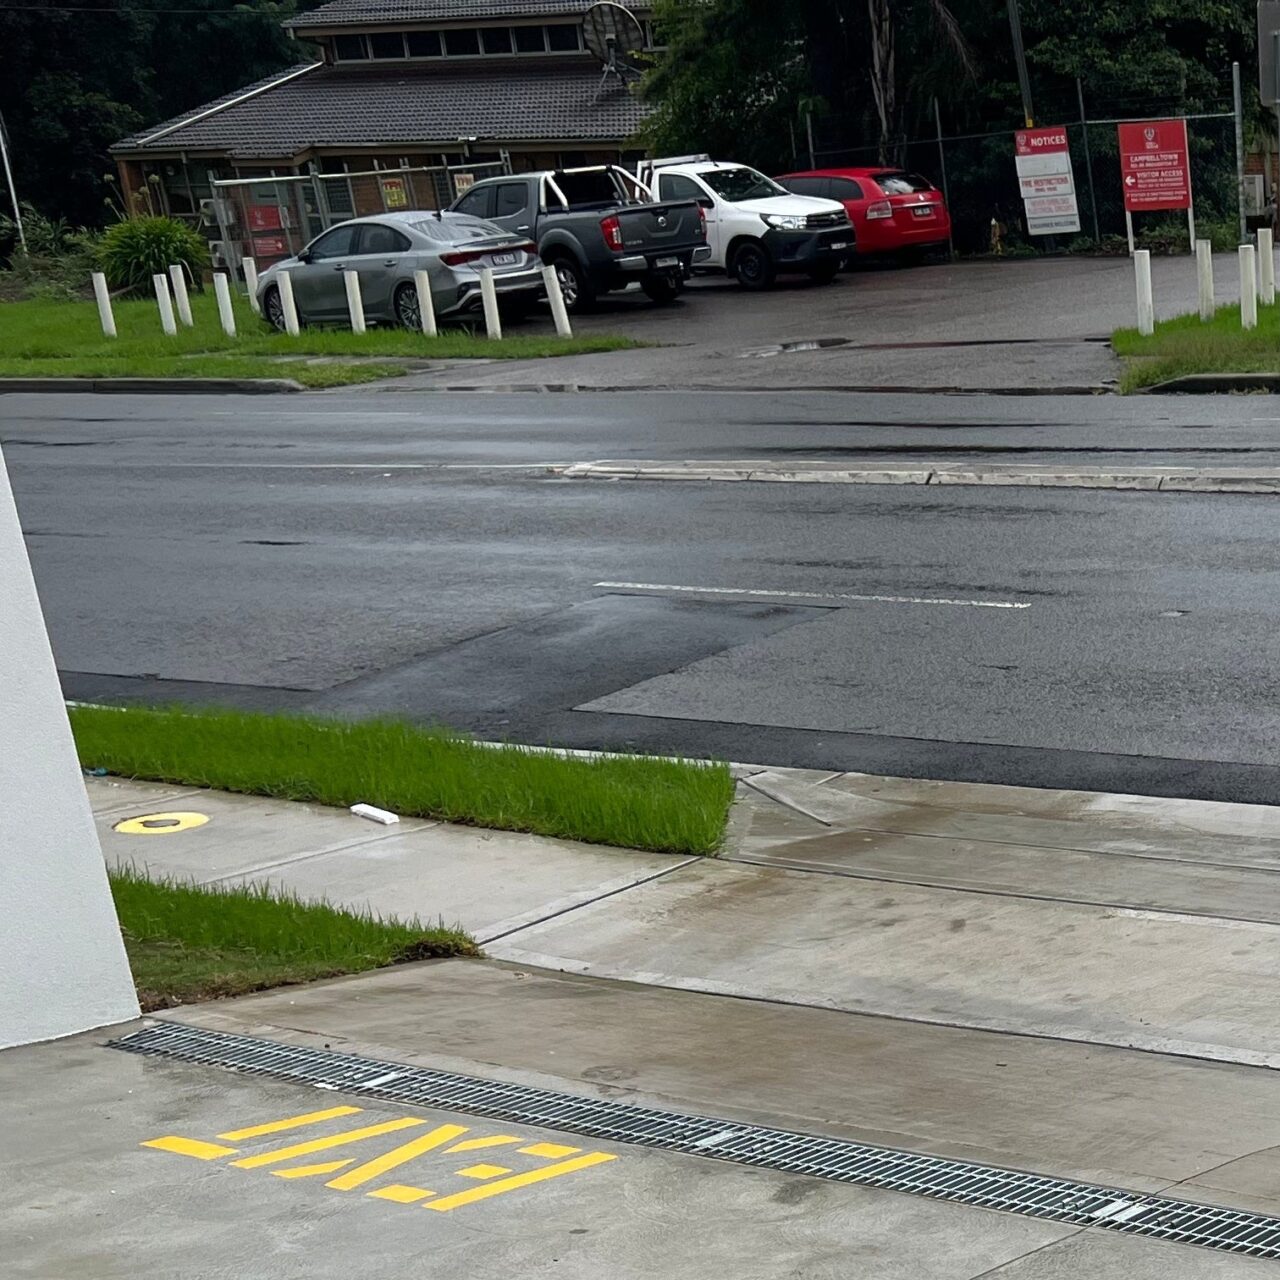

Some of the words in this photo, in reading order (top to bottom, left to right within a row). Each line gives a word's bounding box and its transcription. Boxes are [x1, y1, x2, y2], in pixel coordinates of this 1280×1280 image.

[1031, 135, 1067, 147] NOTICES
[1160, 169, 1183, 177] ACCESS
[140, 1105, 618, 1211] EXIT
